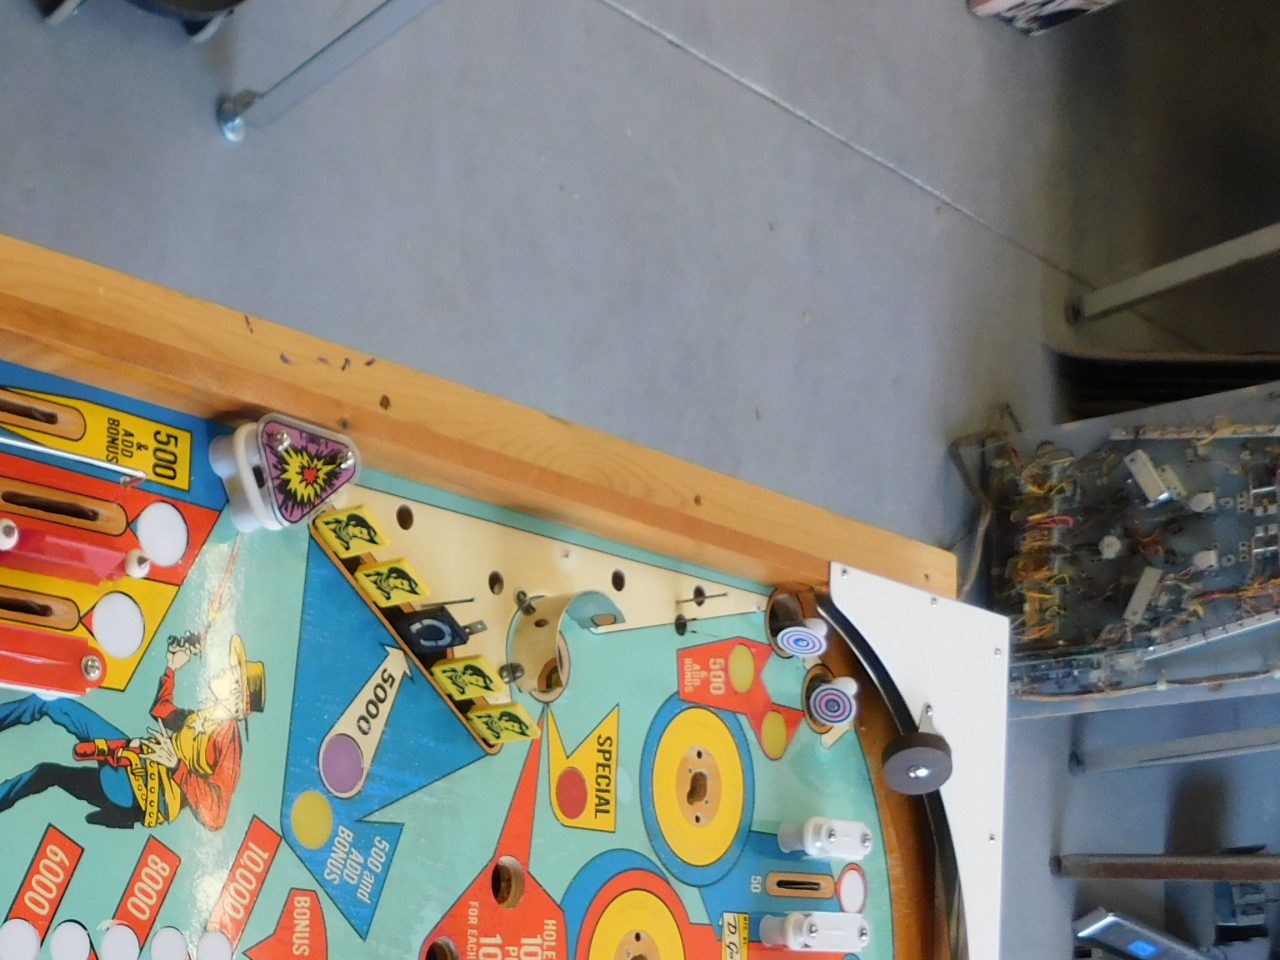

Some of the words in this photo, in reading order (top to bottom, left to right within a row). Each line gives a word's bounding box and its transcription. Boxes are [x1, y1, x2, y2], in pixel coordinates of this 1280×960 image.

[106, 417, 120, 465] BONUS
[121, 429, 135, 458] ADD
[136, 442, 149, 451] &
[152, 430, 178, 480] 500
[683, 657, 693, 693] BONUS
[692, 663, 701, 686] ADD
[709, 657, 725, 696] 500
[356, 667, 396, 737] 5000
[594, 734, 613, 820] SPECIAL
[323, 825, 354, 884] BONUS
[343, 847, 364, 884] ADD
[367, 835, 390, 873] 500
[24, 844, 70, 917] 6000
[126, 854, 169, 921] 8000
[221, 840, 270, 921] 10,000
[356, 870, 375, 904] and
[750, 875, 762, 894] 50
[293, 896, 310, 957] BONUS
[467, 900, 479, 925] FOR
[466, 929, 478, 959] EACH
[543, 919, 557, 960] HOLE
